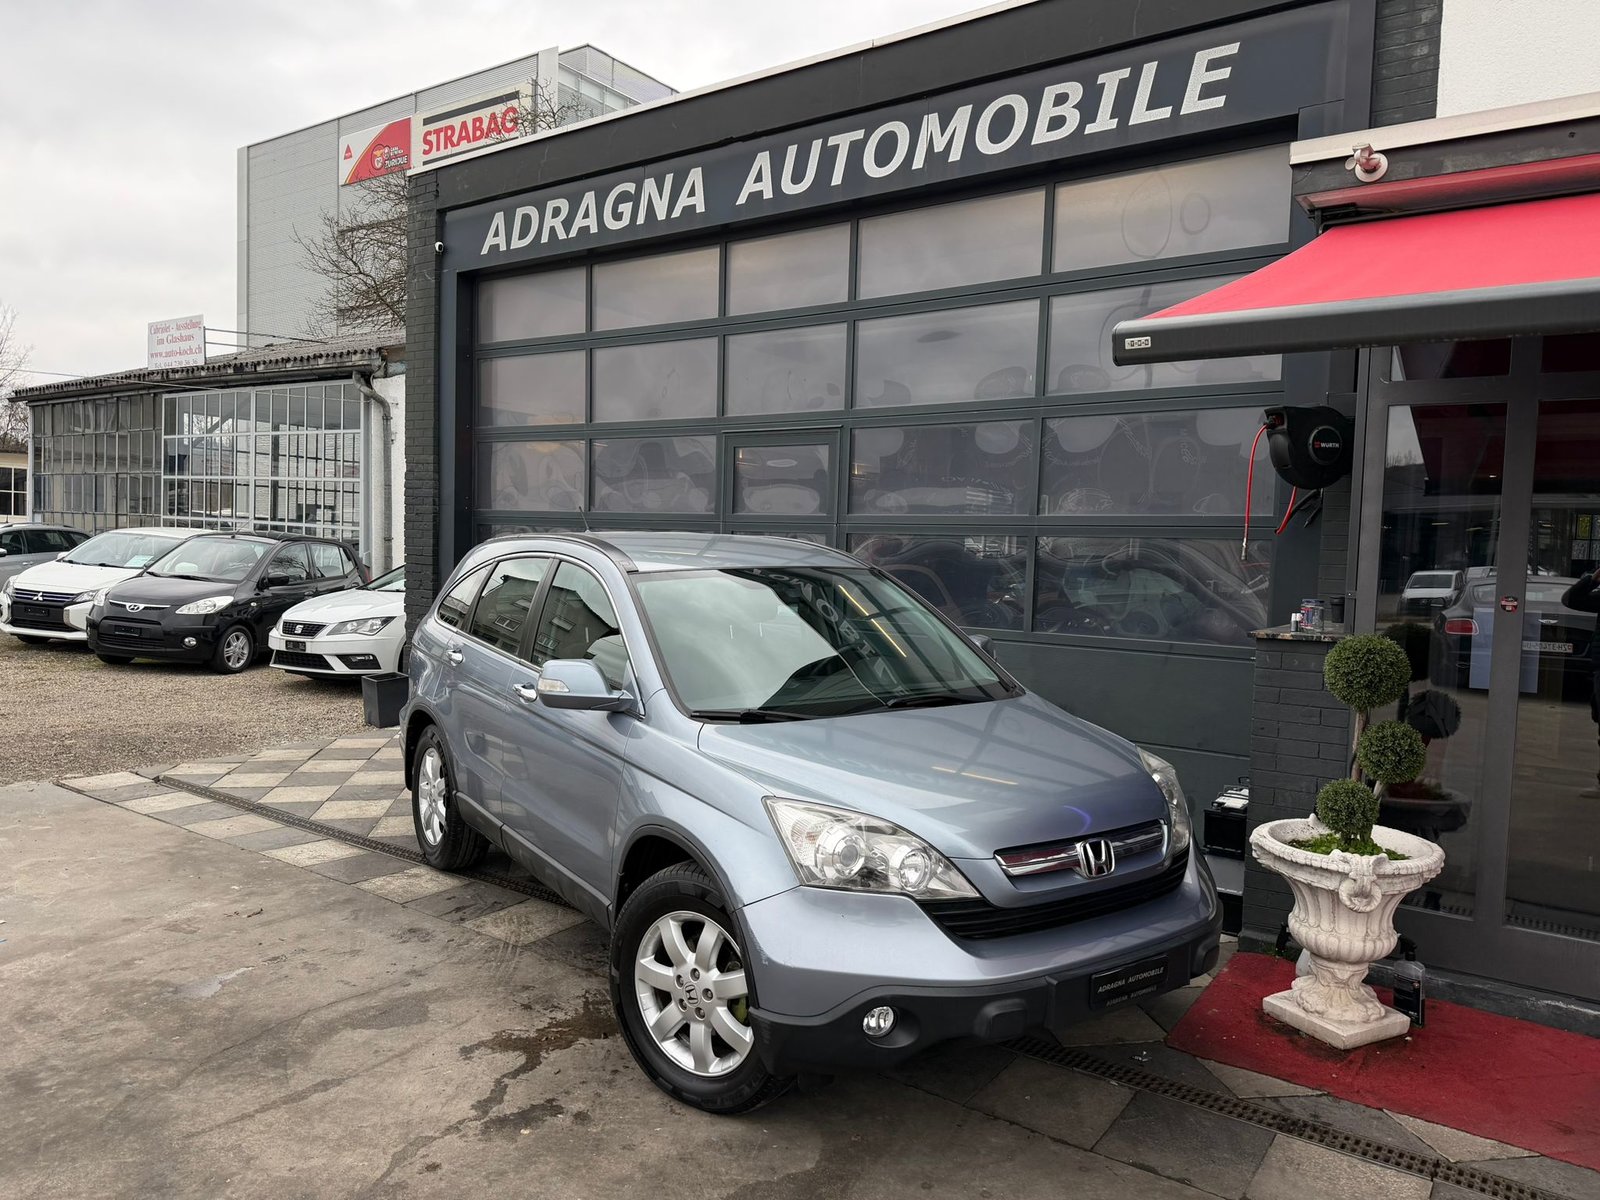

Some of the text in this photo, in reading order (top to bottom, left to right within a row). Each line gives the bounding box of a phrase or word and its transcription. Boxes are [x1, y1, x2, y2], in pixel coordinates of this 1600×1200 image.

[422, 106, 519, 156] STRABAG
[480, 41, 1241, 256] ADRAGNA AUTOMOBILE
[1097, 967, 1165, 993] ADRAGNA AUTOMOBILE
